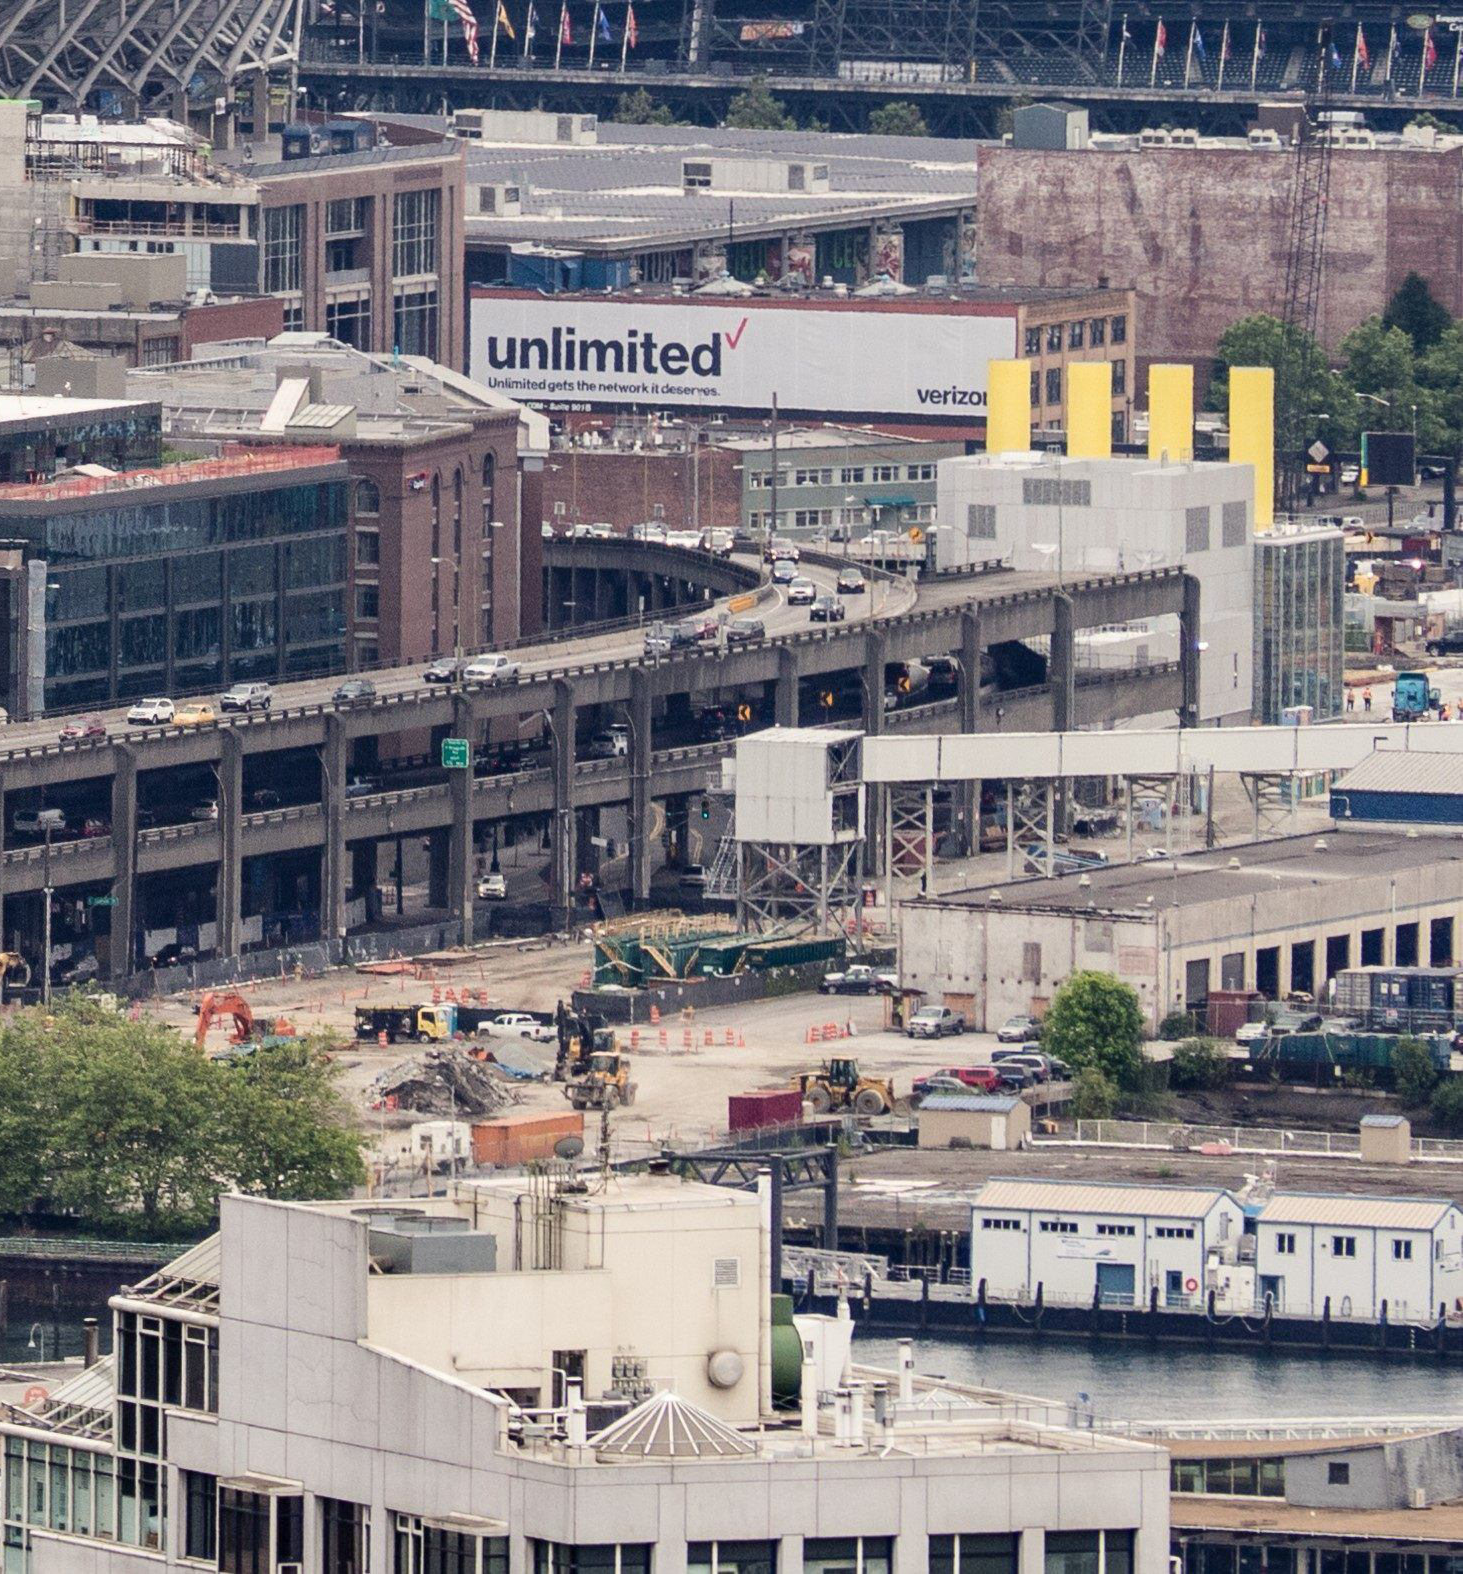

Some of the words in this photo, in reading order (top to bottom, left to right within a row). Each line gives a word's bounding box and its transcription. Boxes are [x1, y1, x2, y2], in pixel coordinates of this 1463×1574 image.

[488, 327, 722, 376] unlimited
[488, 377, 546, 390] Unlimited
[548, 380, 575, 393] gets
[577, 380, 596, 391] the
[598, 382, 649, 394] network
[651, 383, 659, 394] it
[661, 384, 721, 397] deserves.
